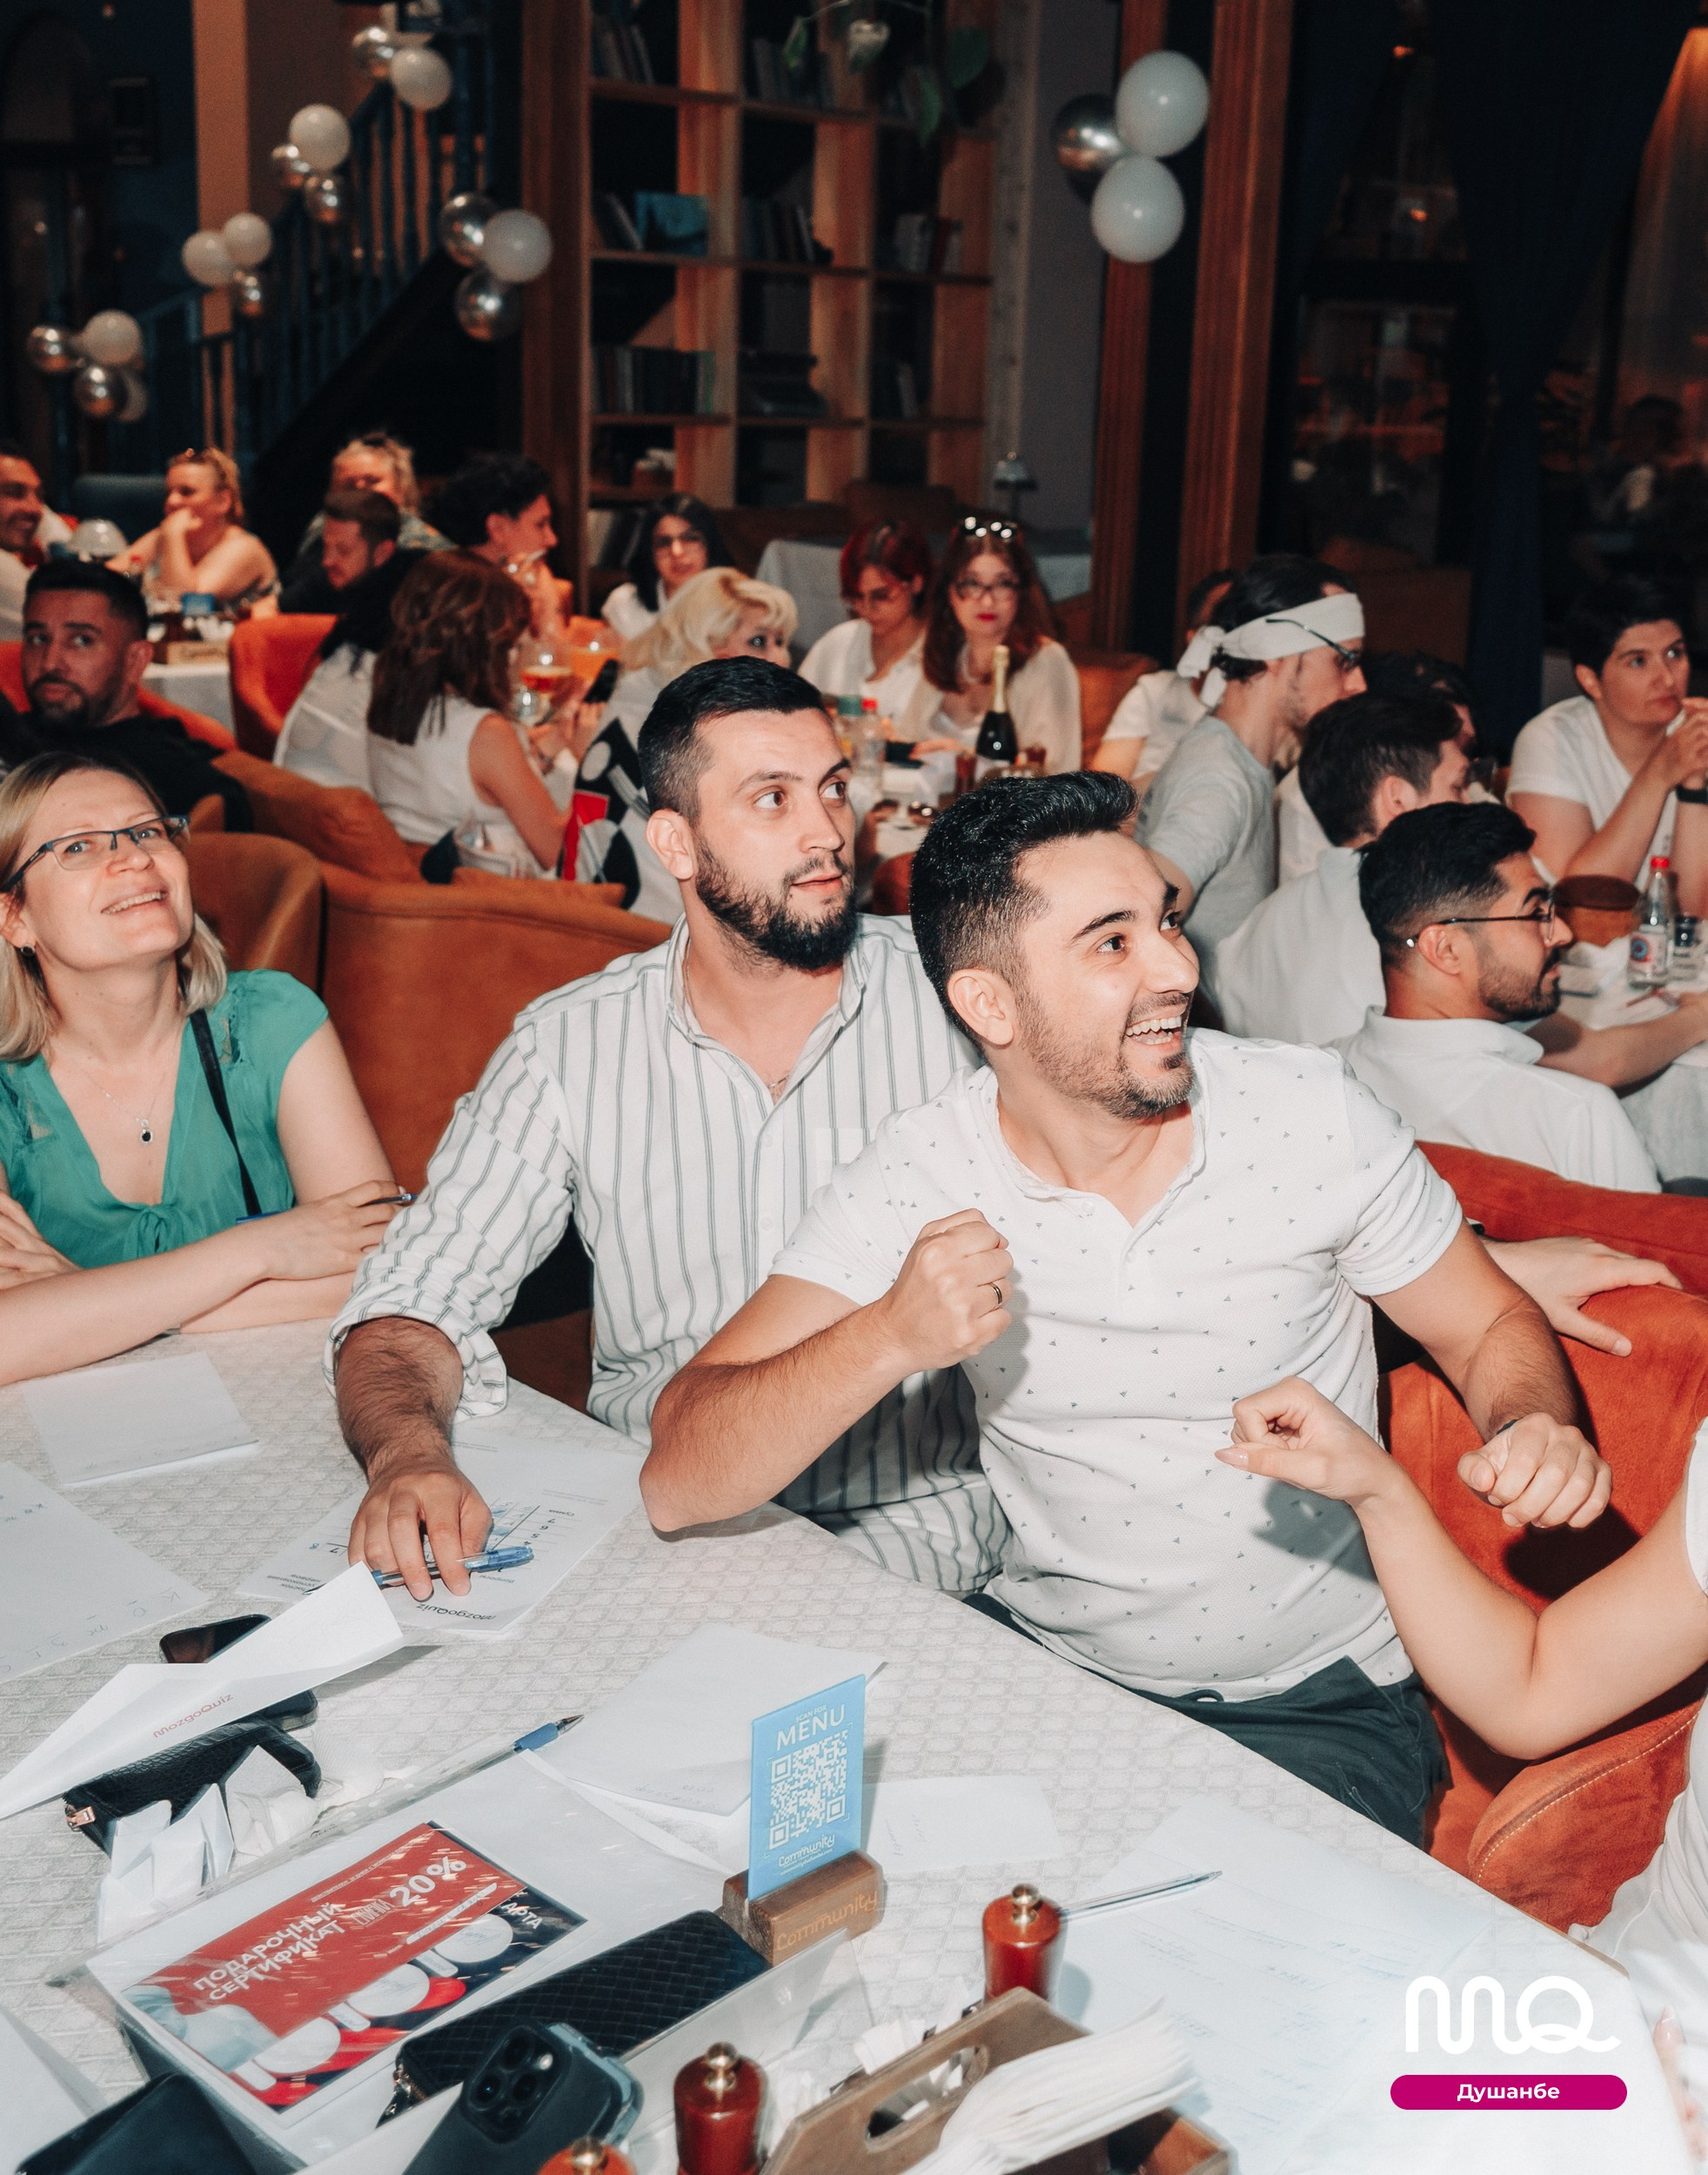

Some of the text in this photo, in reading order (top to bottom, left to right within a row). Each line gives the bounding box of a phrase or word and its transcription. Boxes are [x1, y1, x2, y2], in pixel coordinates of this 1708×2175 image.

[776, 1704, 846, 1751] MENU
[795, 1704, 828, 1722] SCAN FOR
[779, 1834, 835, 1867] Community
[193, 1902, 345, 1991] ПОДАРОЧНЫЙ
[777, 1889, 878, 1951] Community
[209, 1919, 345, 2000] СЕРТИФИКАТ
